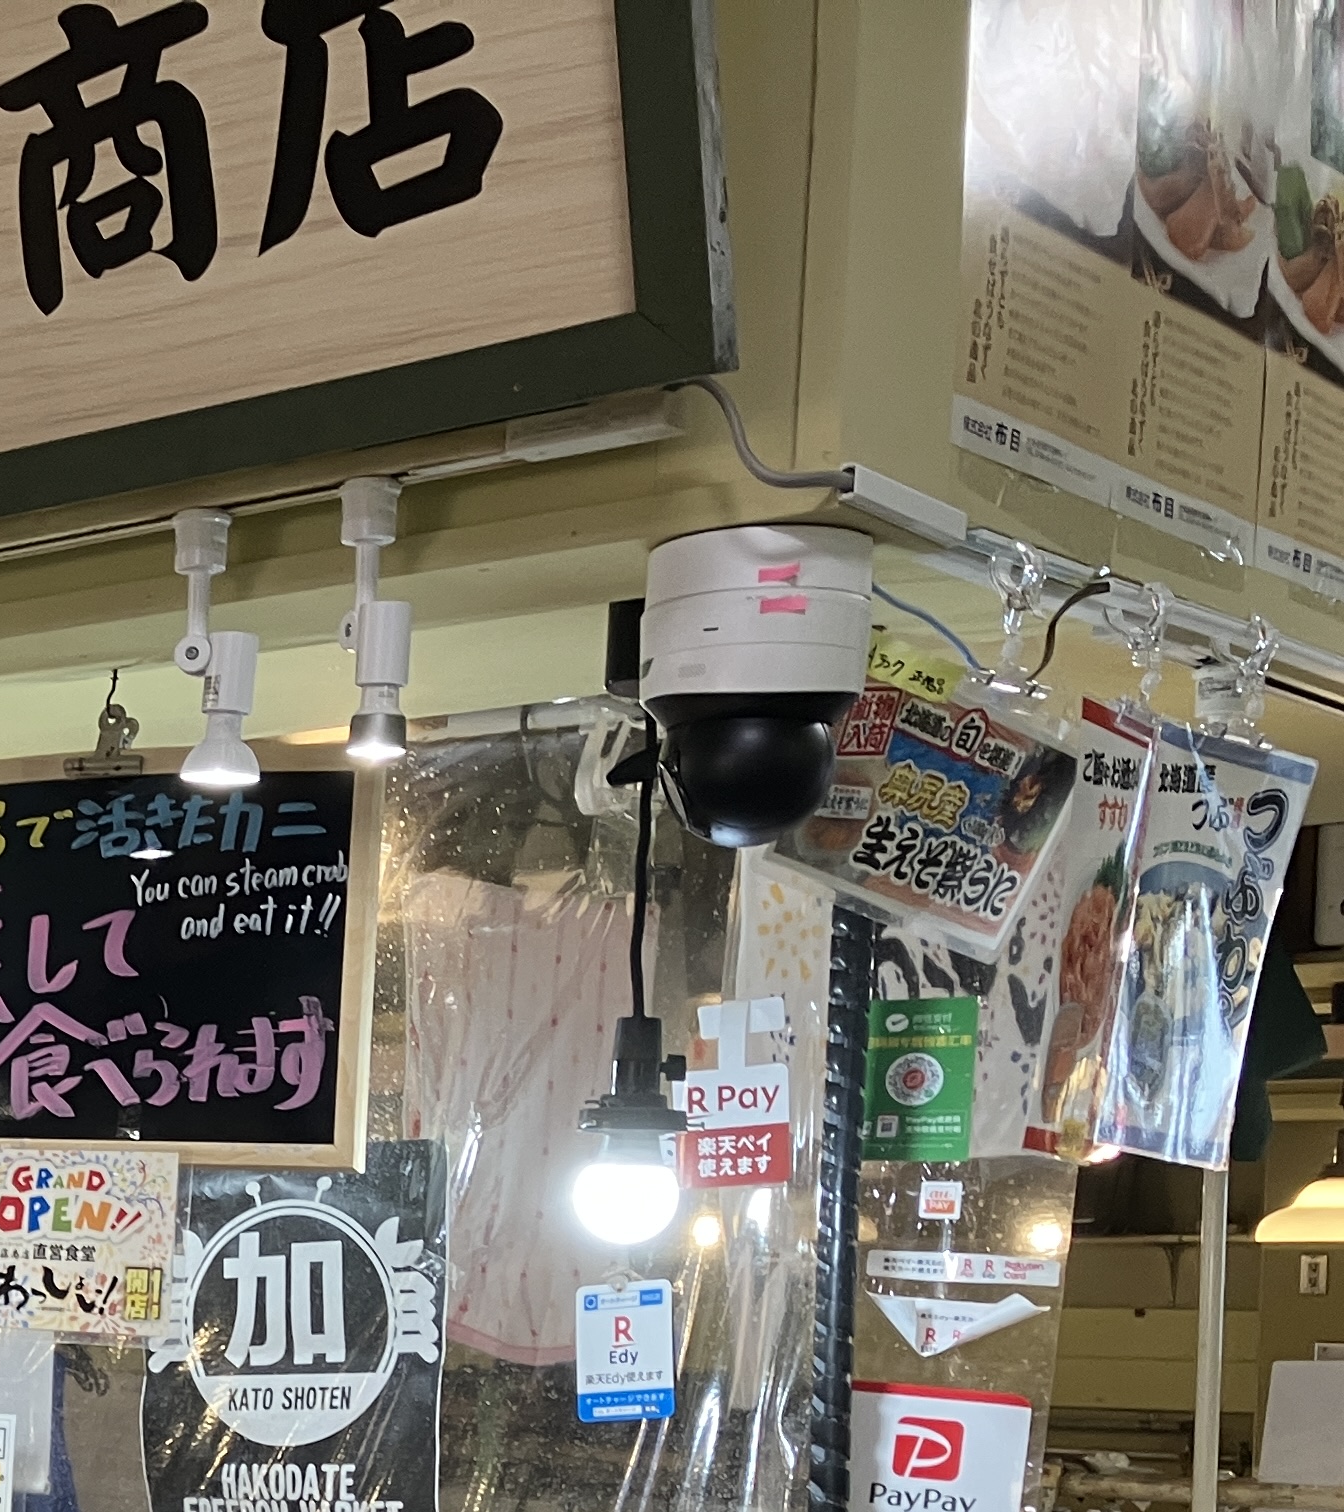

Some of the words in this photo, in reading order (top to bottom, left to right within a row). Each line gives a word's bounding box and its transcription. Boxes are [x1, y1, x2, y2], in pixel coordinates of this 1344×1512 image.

[130, 870, 170, 908] You
[177, 872, 217, 900] can
[225, 859, 299, 895] steam
[180, 905, 223, 940] and
[234, 903, 275, 936] eat
[718, 1082, 781, 1114] Pay
[697, 1133, 773, 1157] 楽天ペイ
[12, 1165, 106, 1193] GRAND
[697, 1156, 773, 1178] 使えます
[223, 1232, 348, 1367] 加
[609, 1348, 639, 1365] Edy
[228, 1386, 273, 1411] KATO
[281, 1385, 352, 1411] SHOTEN
[220, 1463, 356, 1503] HAKODATE
